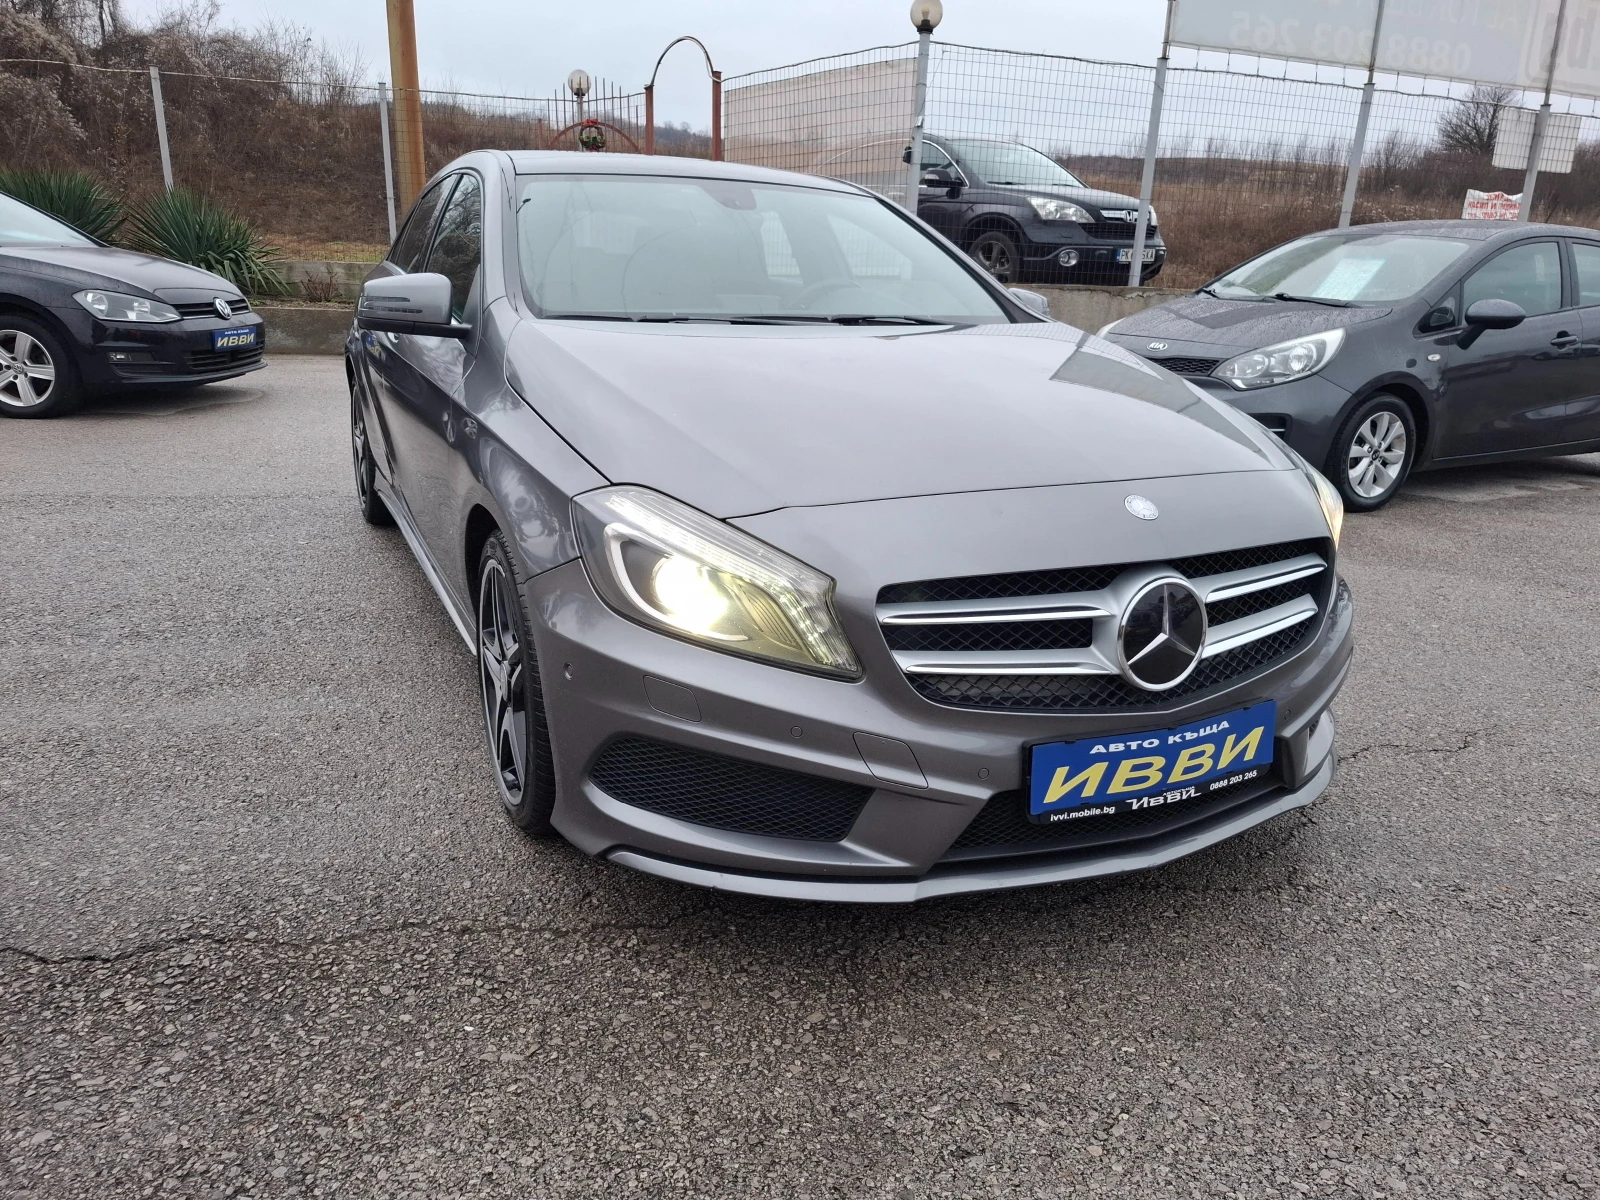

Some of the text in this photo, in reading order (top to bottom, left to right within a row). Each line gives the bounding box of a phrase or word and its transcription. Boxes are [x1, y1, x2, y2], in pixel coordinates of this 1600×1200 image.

[218, 333, 254, 347] ИВВИ
[1089, 720, 1230, 754] АВТО КЪЩА
[1043, 726, 1265, 804] ИВВИ
[1209, 769, 1258, 790] 0888 203 265
[1125, 788, 1202, 810] ИВВИ
[1050, 806, 1116, 822] ivvi.mobile.bg
